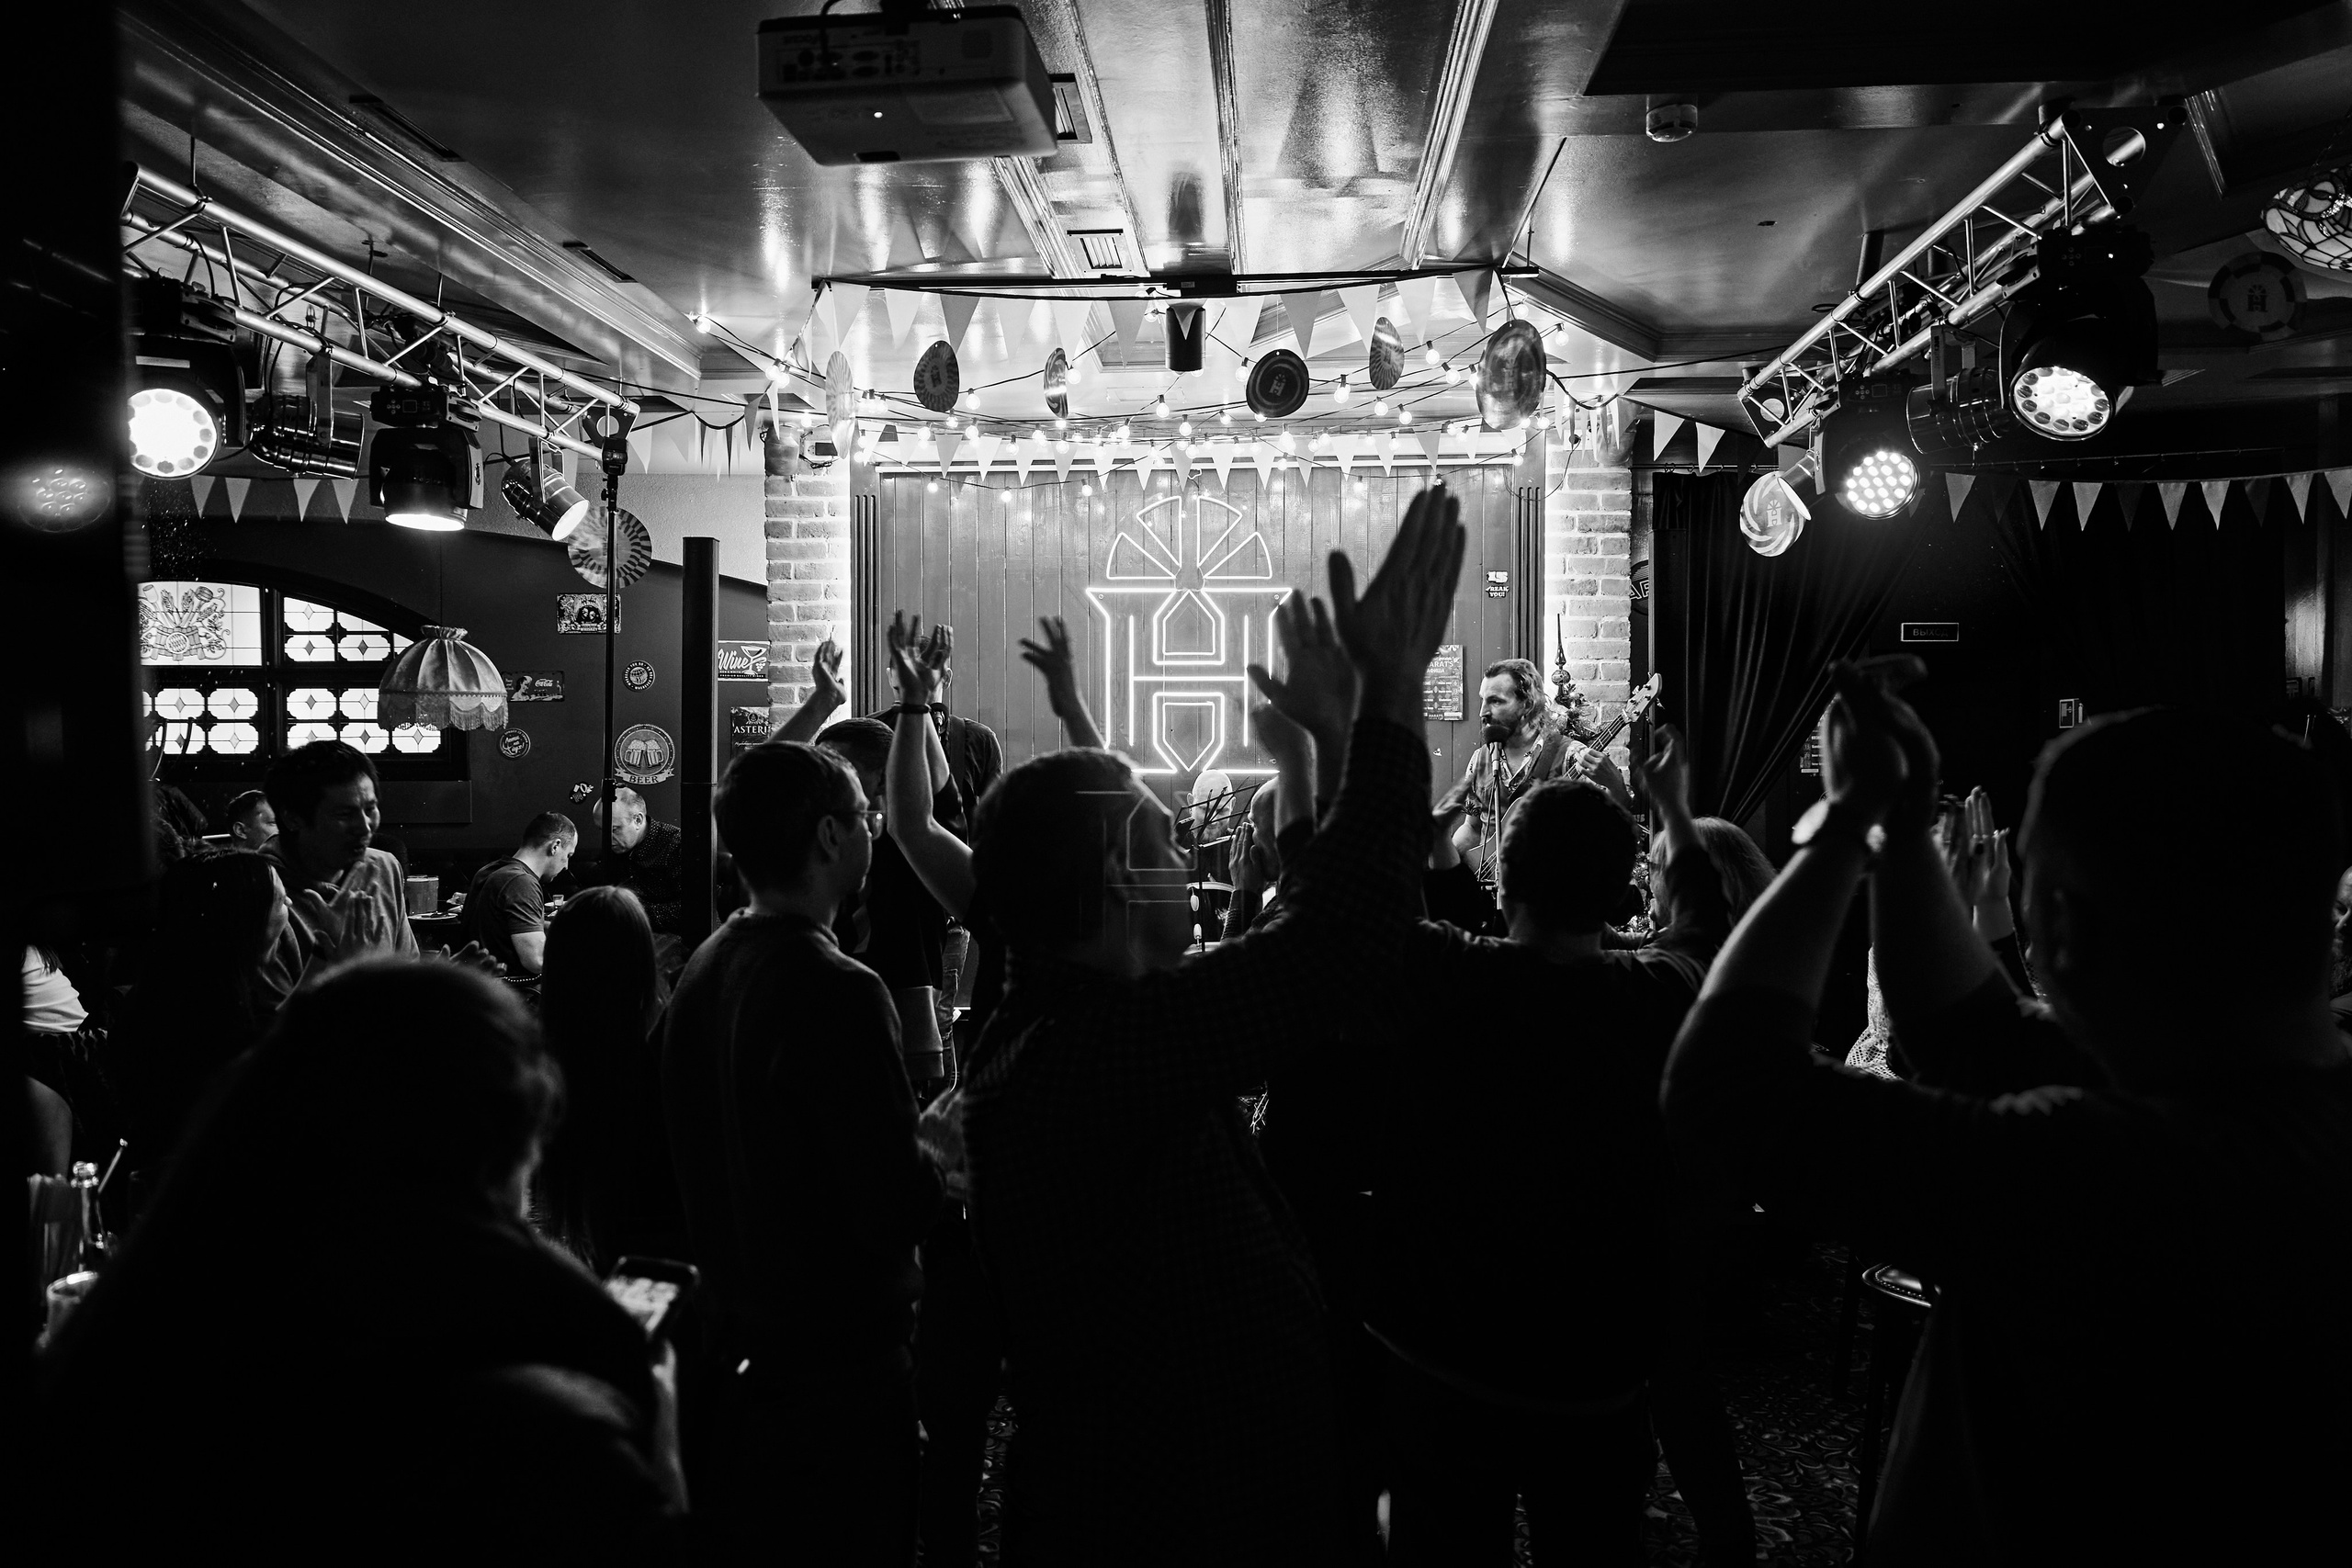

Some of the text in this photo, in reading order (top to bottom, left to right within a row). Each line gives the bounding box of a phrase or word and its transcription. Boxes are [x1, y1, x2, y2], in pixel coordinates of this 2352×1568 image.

[1913, 628, 1949, 637] ВЫХОД
[718, 648, 749, 671] Wine
[629, 775, 659, 784] BEER
